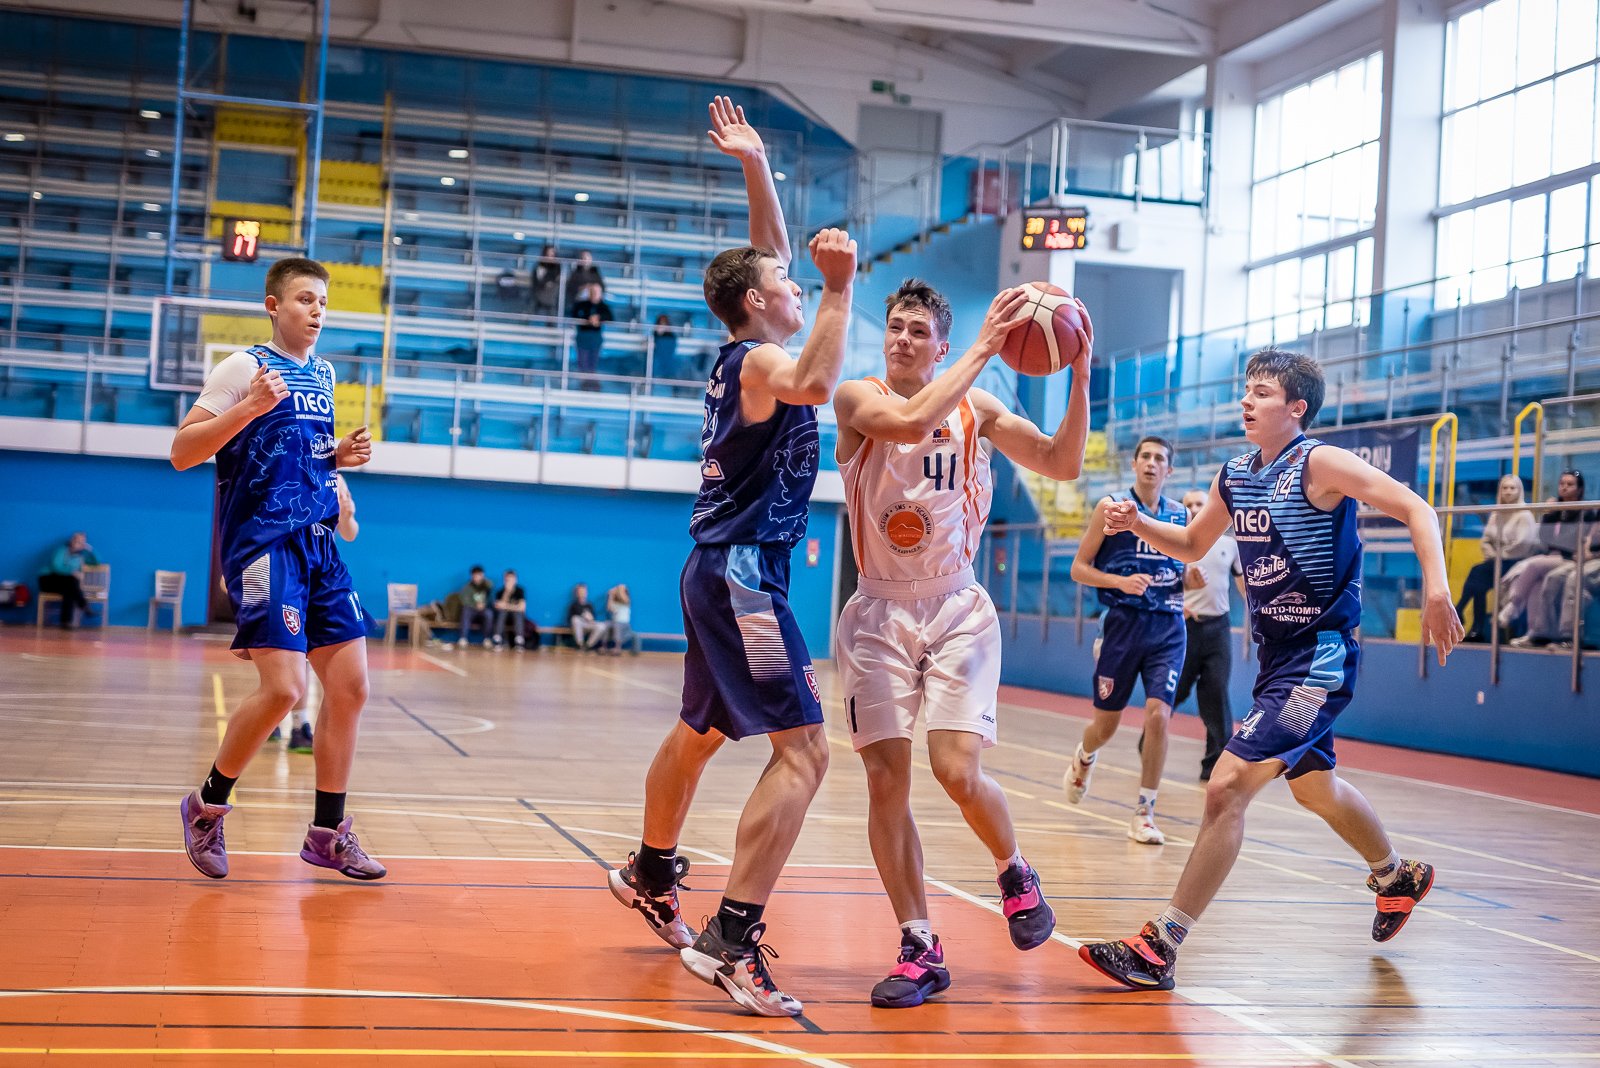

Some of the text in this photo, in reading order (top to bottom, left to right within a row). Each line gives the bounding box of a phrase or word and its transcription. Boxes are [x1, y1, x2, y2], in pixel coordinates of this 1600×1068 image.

[923, 452, 957, 491] 41
[1272, 470, 1297, 500] 14
[880, 503, 932, 535] LICEUM SMS TECHNIKUM
[1261, 605, 1321, 615] AUTO-KOMIS
[1165, 669, 1179, 692] 5
